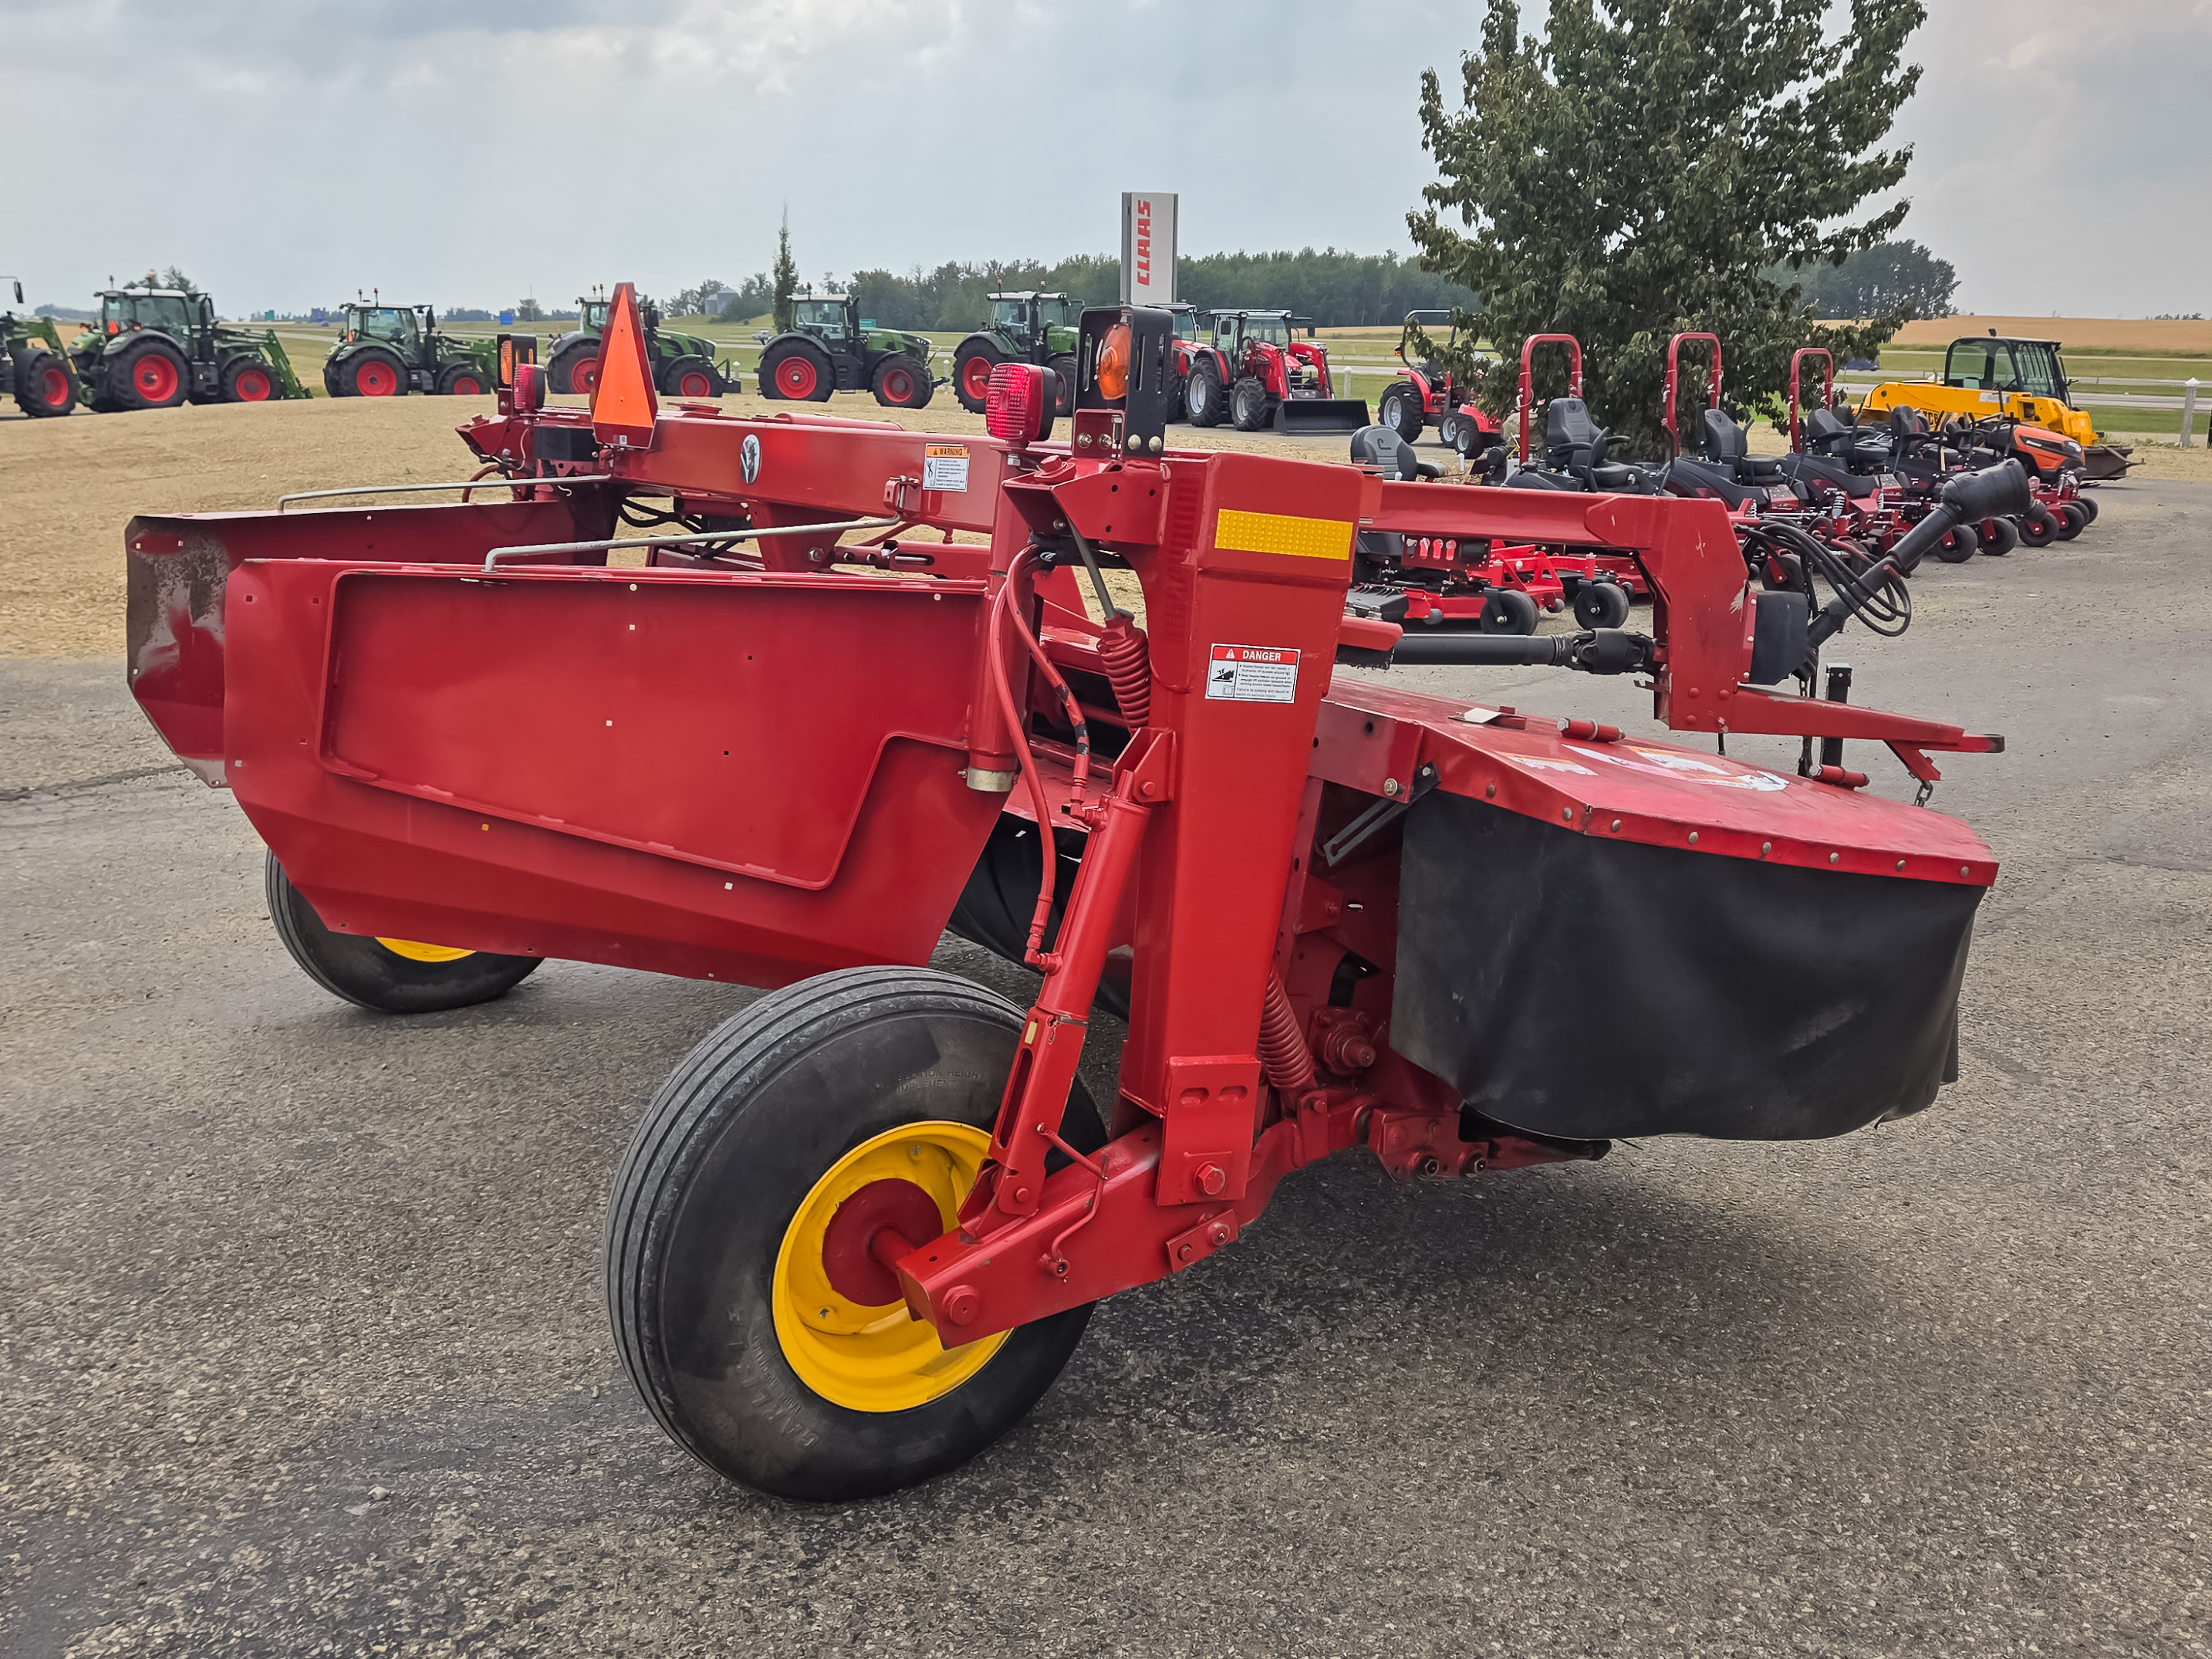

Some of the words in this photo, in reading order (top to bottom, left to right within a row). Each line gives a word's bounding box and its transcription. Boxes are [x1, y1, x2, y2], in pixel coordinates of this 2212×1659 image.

[1137, 199, 1151, 286] CLAAS
[939, 448, 963, 456] WARNING
[1242, 650, 1282, 661] DANGER
[897, 1069, 943, 1083] SECTION
[947, 1069, 984, 1080] HEIGHT
[897, 1079, 957, 1093] IMPLEMENT
[725, 1307, 821, 1451] CARLISLE
